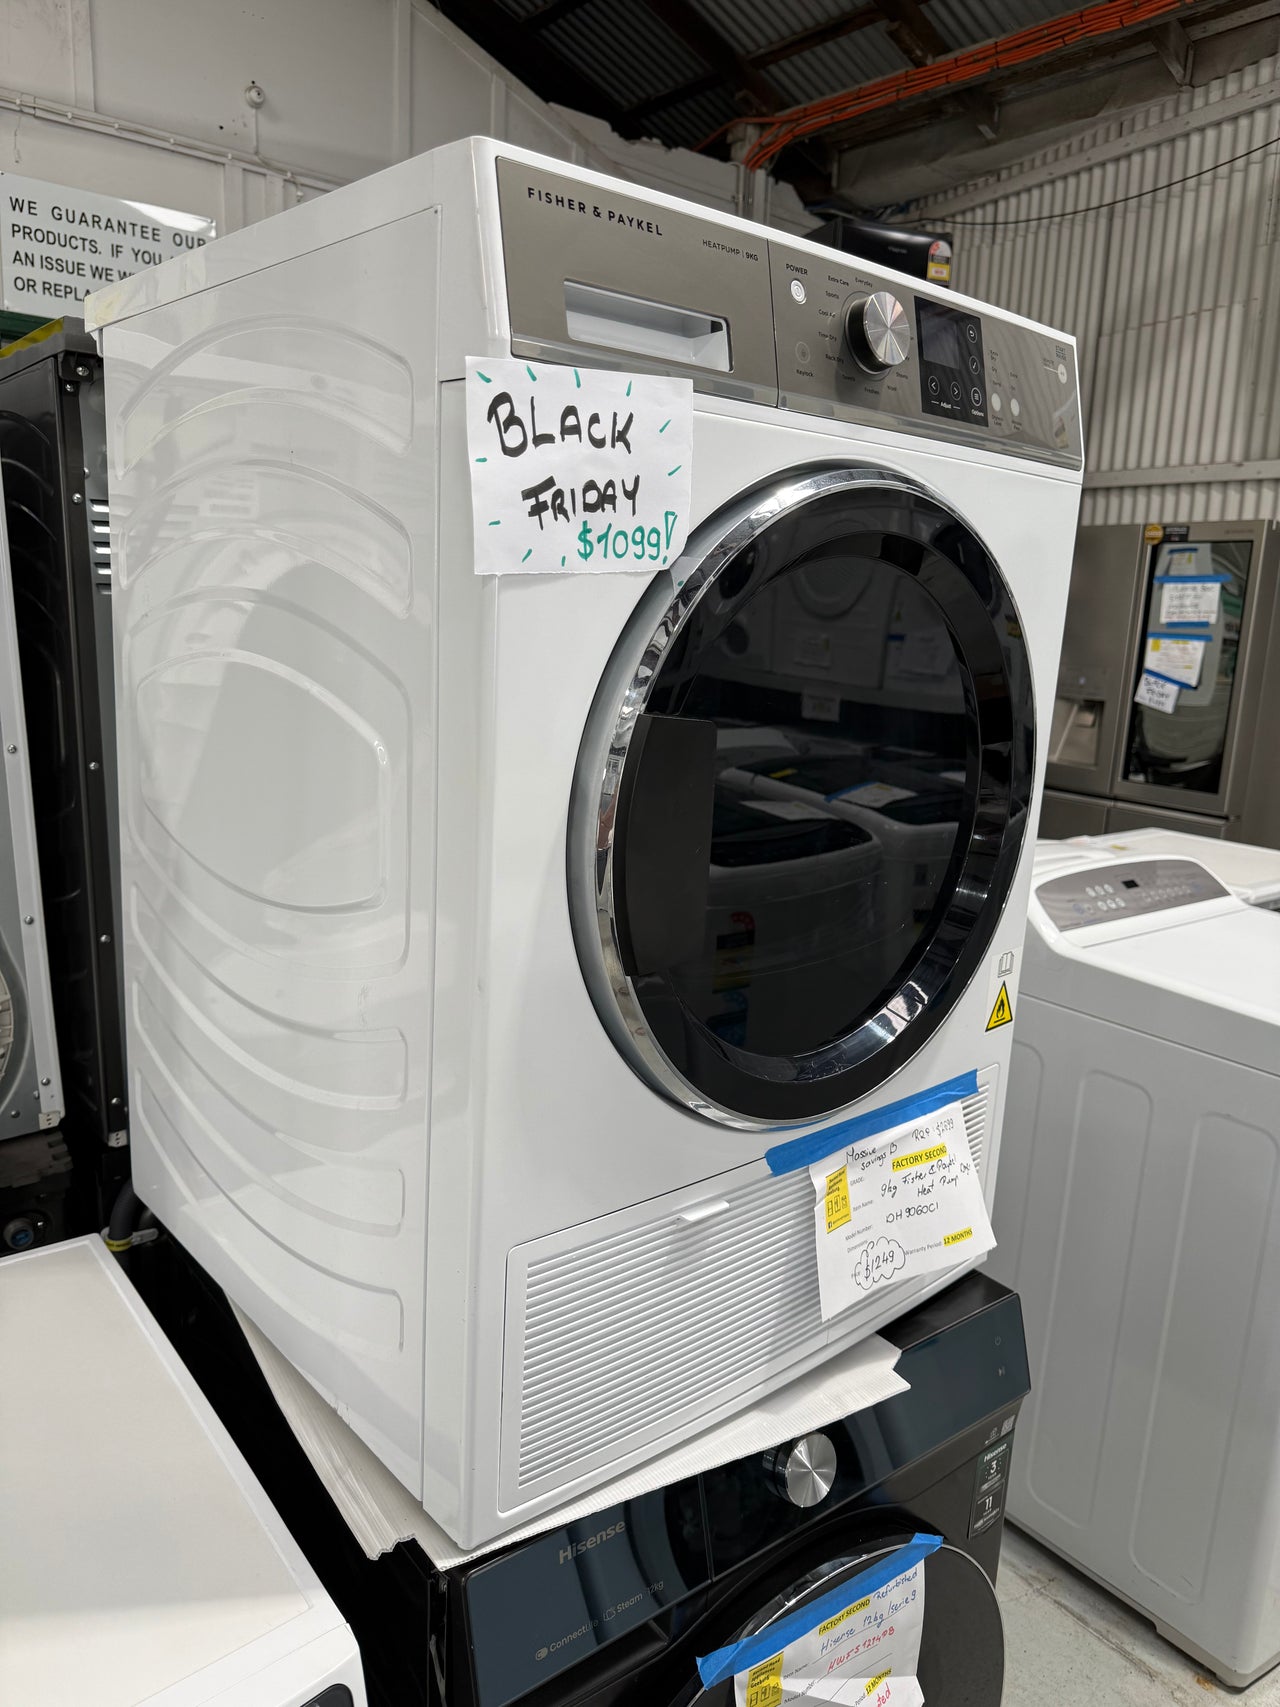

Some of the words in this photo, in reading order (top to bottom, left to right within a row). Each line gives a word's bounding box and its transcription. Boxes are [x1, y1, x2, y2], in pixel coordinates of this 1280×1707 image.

[9, 196, 38, 216] WE
[51, 206, 161, 242] GUARANTEE
[527, 187, 586, 214] FISHER
[592, 206, 602, 218] &
[608, 210, 663, 236] PAYKEL
[11, 223, 102, 255] PRODUCTS.
[111, 244, 123, 259] IF
[131, 248, 162, 265] YOU
[702, 239, 741, 256] HEATPUMP
[745, 251, 759, 262] 9KG
[13, 251, 35, 268] AN
[40, 255, 85, 277] ISSUE
[90, 265, 114, 282] WE
[786, 263, 808, 275] POWER
[14, 276, 37, 293] OR
[487, 391, 634, 458] BLACK
[521, 475, 640, 531] FRIDAY
[577, 511, 678, 565] $1099!
[892, 1153, 924, 1169] FACTORY
[924, 1145, 947, 1161] SECOND
[944, 1237, 950, 1245] 12
[951, 1228, 973, 1242] MONTHS
[864, 1250, 895, 1281] $1249
[559, 1521, 625, 1565] Hisense
[616, 1593, 643, 1613] Steam
[818, 1613, 845, 1636] FACTORY
[845, 1598, 871, 1618] SECOND
